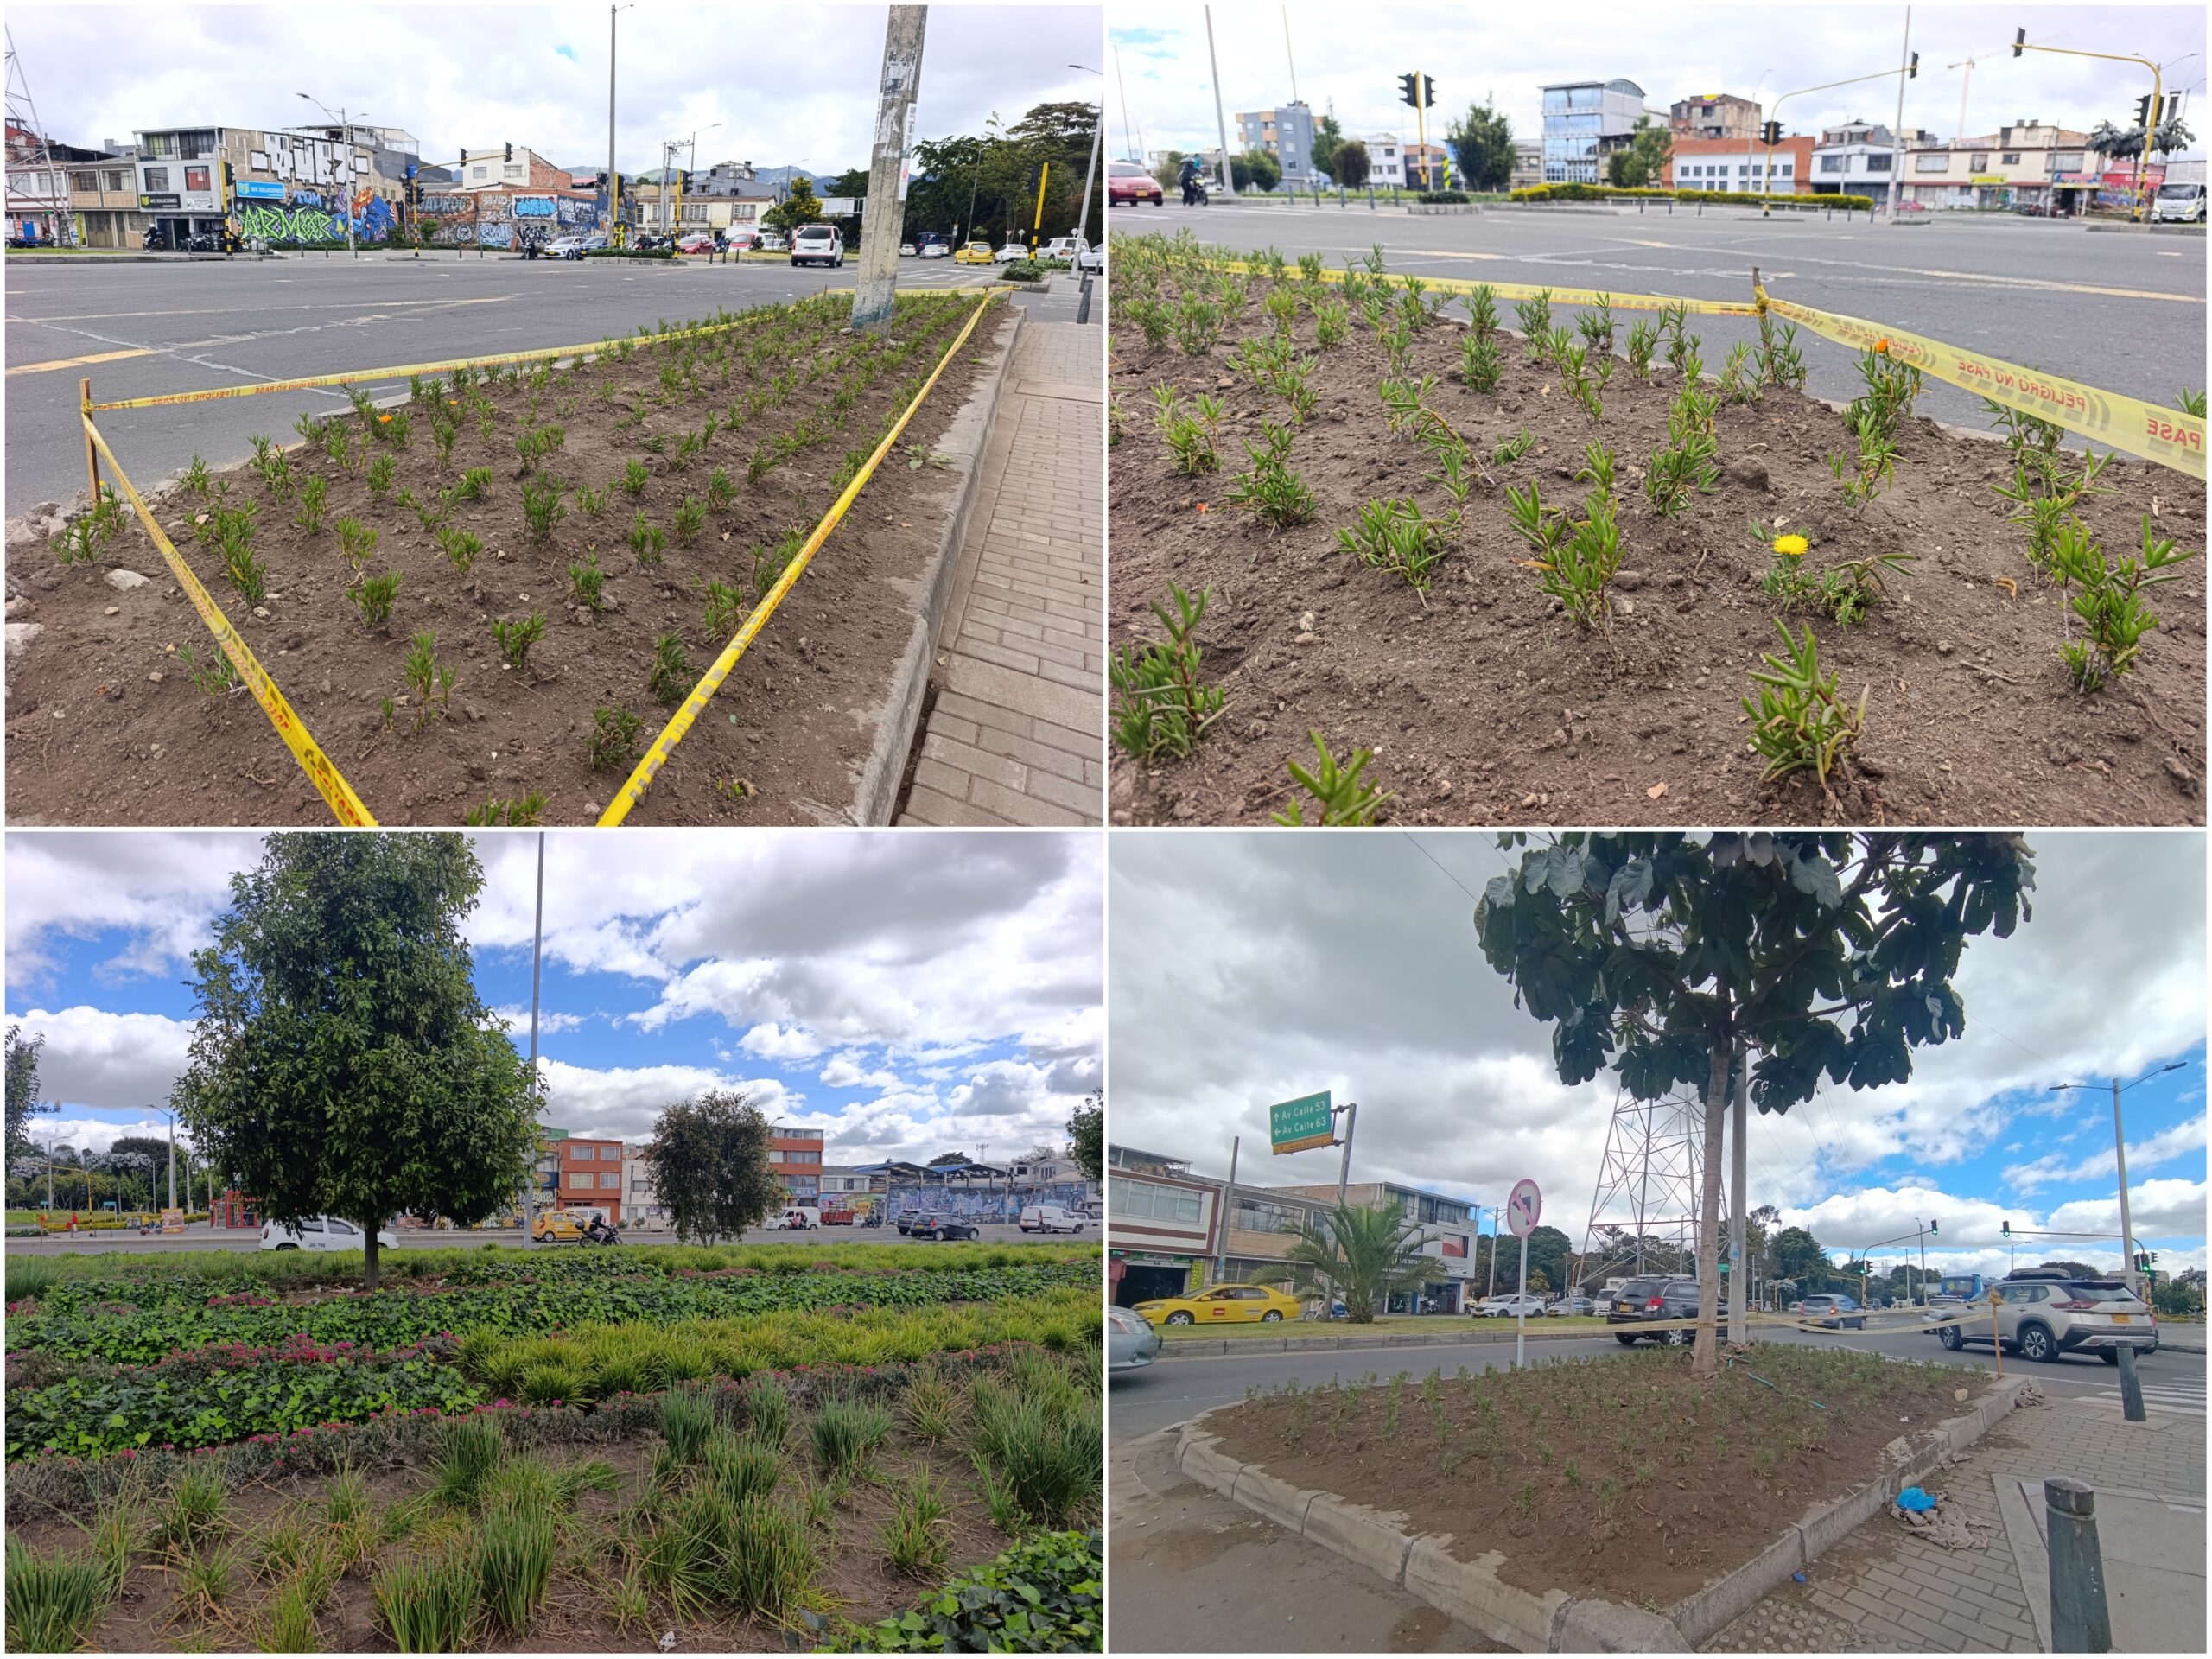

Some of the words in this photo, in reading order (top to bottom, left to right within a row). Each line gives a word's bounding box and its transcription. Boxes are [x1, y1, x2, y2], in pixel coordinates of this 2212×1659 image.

[1281, 1111, 1291, 1120] Av
[1294, 1106, 1313, 1116] Calle
[1315, 1101, 1325, 1111] 53
[1282, 1126, 1292, 1135] Av
[1294, 1122, 1313, 1132] Calle
[1315, 1116, 1326, 1127] 63
